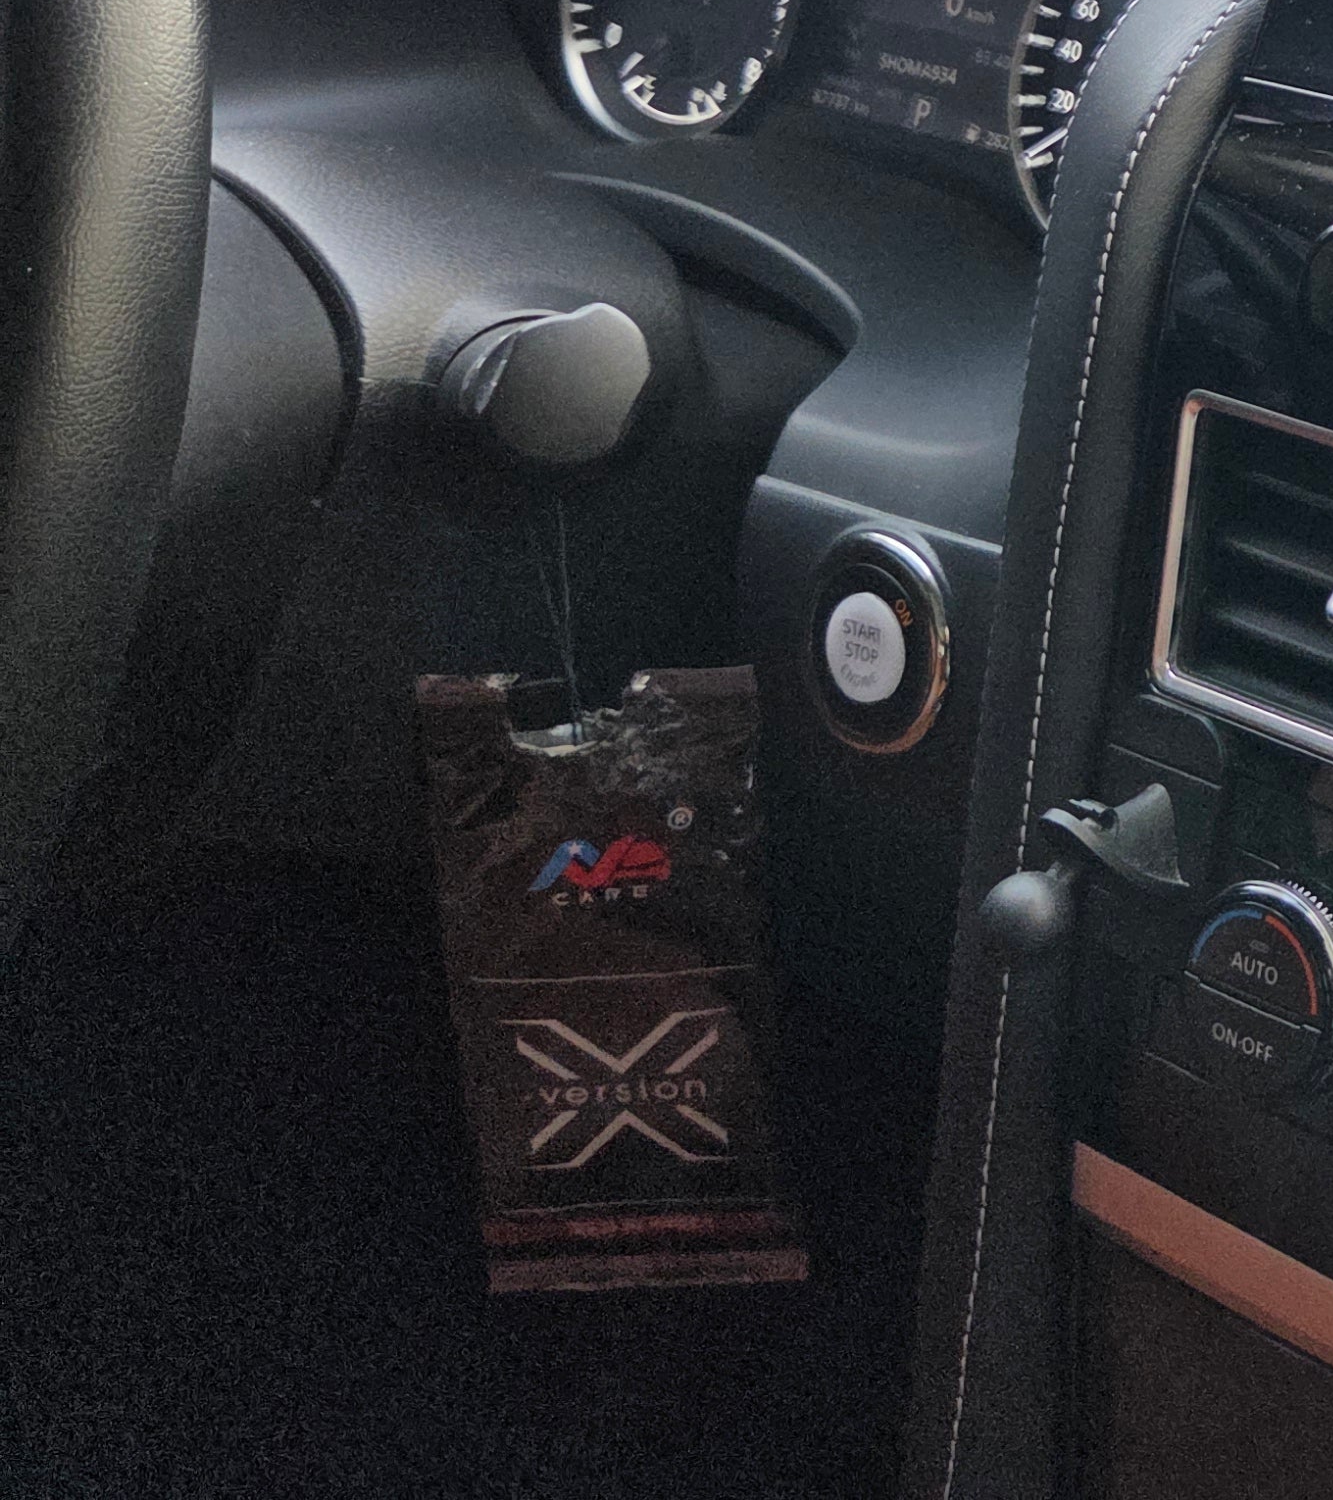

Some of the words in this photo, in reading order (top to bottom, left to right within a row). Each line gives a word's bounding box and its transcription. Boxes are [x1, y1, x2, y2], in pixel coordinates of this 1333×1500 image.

[1054, 38, 1083, 63] 40
[1047, 88, 1075, 115] 20
[894, 598, 914, 628] ON
[842, 618, 881, 644] START
[844, 641, 879, 664] STOP
[1230, 951, 1280, 987] AUTO
